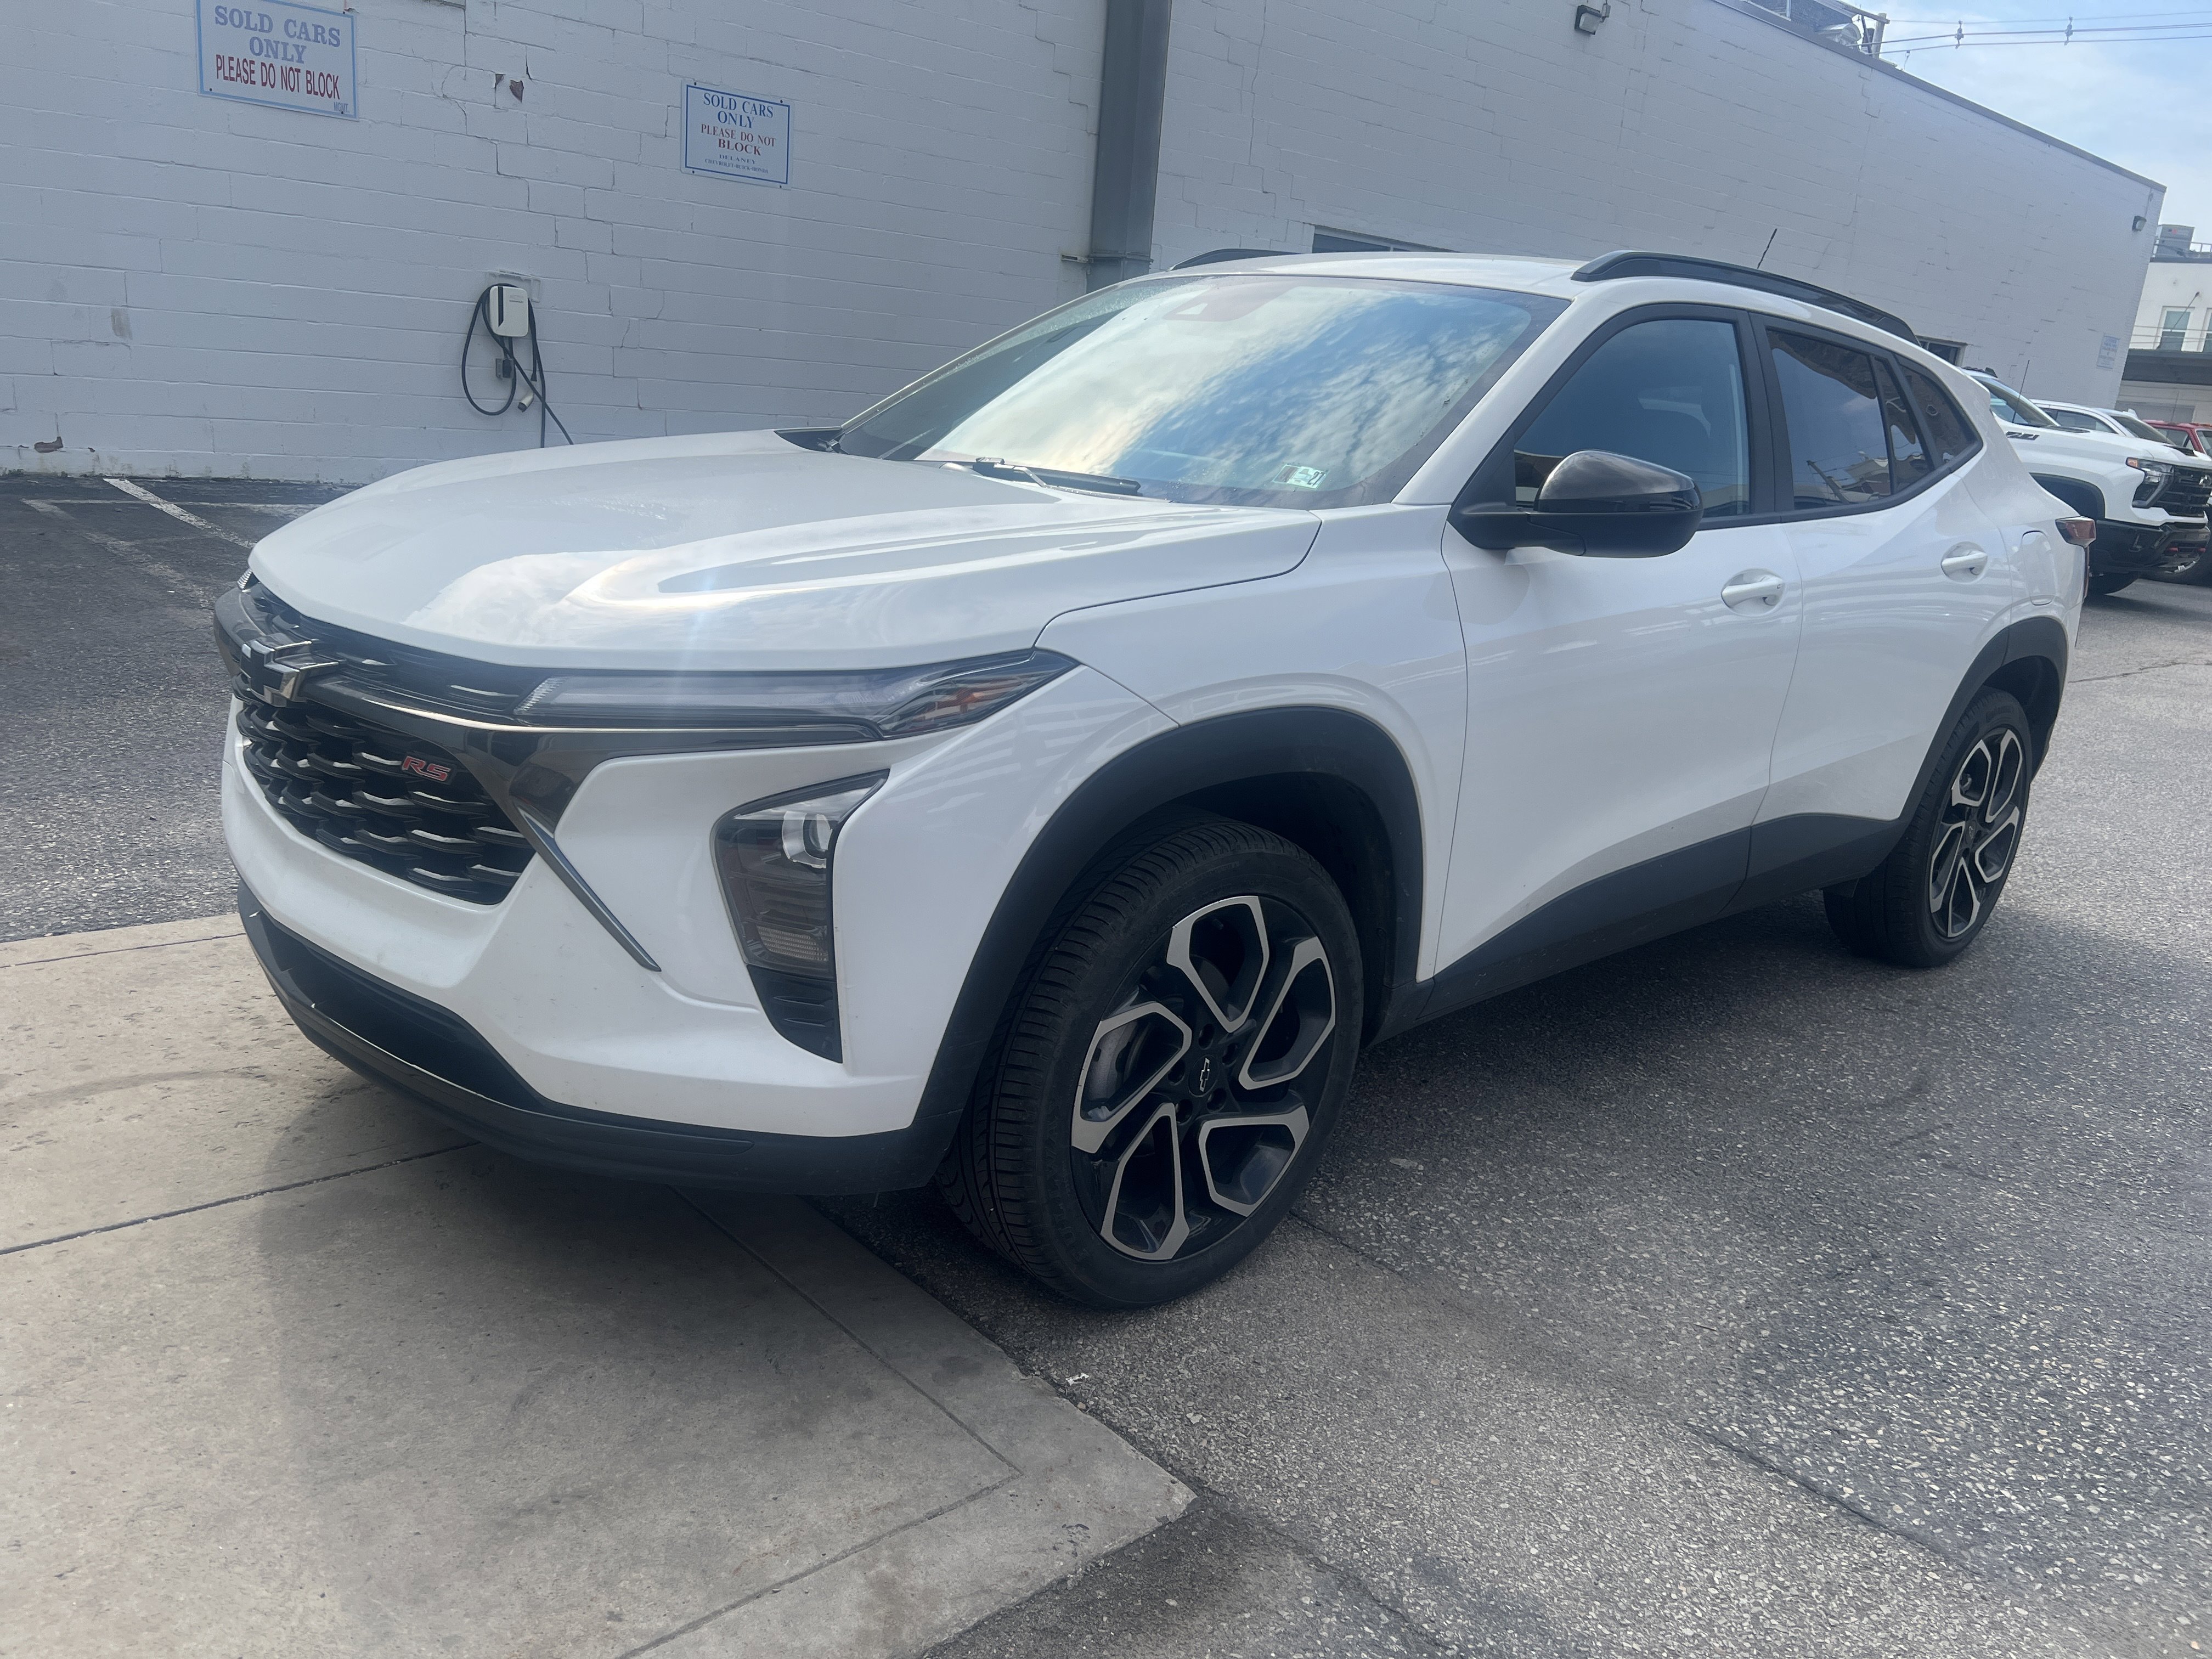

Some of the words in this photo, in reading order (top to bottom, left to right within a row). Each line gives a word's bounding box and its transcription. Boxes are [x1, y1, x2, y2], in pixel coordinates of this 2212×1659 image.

[215, 5, 273, 33] SOLD
[284, 18, 341, 47] CARS
[249, 36, 307, 64] ONLY
[216, 54, 256, 85] PLEASE
[261, 61, 276, 89] DO
[280, 65, 301, 93] NOT
[306, 70, 340, 100] BLOCK
[703, 92, 737, 111] SOLD
[742, 101, 774, 118] CARS
[717, 110, 754, 129] ONLY
[701, 123, 736, 139] PLEASE
[740, 131, 754, 143] DO
[757, 135, 776, 147] NOT
[718, 138, 761, 156] BLOCK
[719, 154, 755, 164] DELANEY
[1307, 471, 1325, 487] 27
[402, 755, 451, 781] RS
